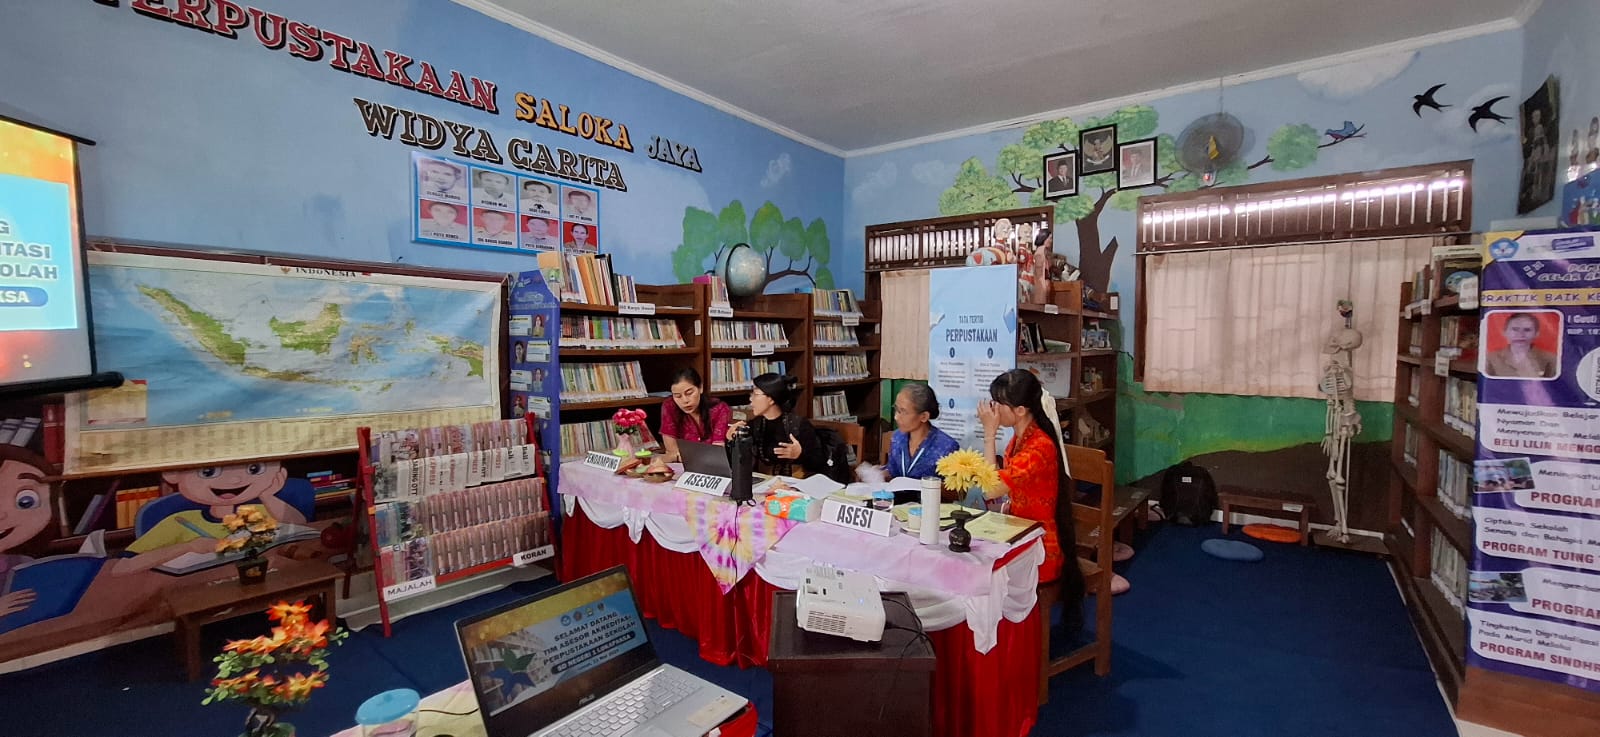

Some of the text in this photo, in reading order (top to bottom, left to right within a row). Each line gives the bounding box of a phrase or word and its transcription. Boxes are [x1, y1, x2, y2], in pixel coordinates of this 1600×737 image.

[93, 0, 702, 172] RPUSTAKAAN SALOKA JAYA
[353, 98, 627, 191] WIDYA CARITA
[295, 267, 356, 277] INDONESIA
[946, 328, 998, 342] PERPUSTAKAAN
[1497, 418, 1535, 426] Nyaman
[1562, 411, 1599, 420] Belajar
[1494, 438, 1519, 447] BELI
[1523, 440, 1552, 449] LILIN
[684, 473, 722, 490] ASESOR
[836, 504, 873, 529] ASESI
[1484, 517, 1569, 532] Ciptakan Sekolah
[1484, 527, 1517, 536] Senang
[520, 549, 547, 561] KORAN
[1482, 541, 1594, 563] PROGRAM TUING
[387, 580, 432, 596] MAJALAH
[554, 612, 618, 642] SELAMAT DATANG
[1480, 620, 1532, 634] Tingkatkan
[543, 622, 636, 665] PERPUSTAKAAN SEKOLAH
[543, 646, 558, 656] TIM
[560, 632, 590, 648] ASESOR
[1478, 629, 1501, 638] Pada
[1505, 634, 1533, 644] Murid
[1480, 641, 1546, 661] PROGRAM
